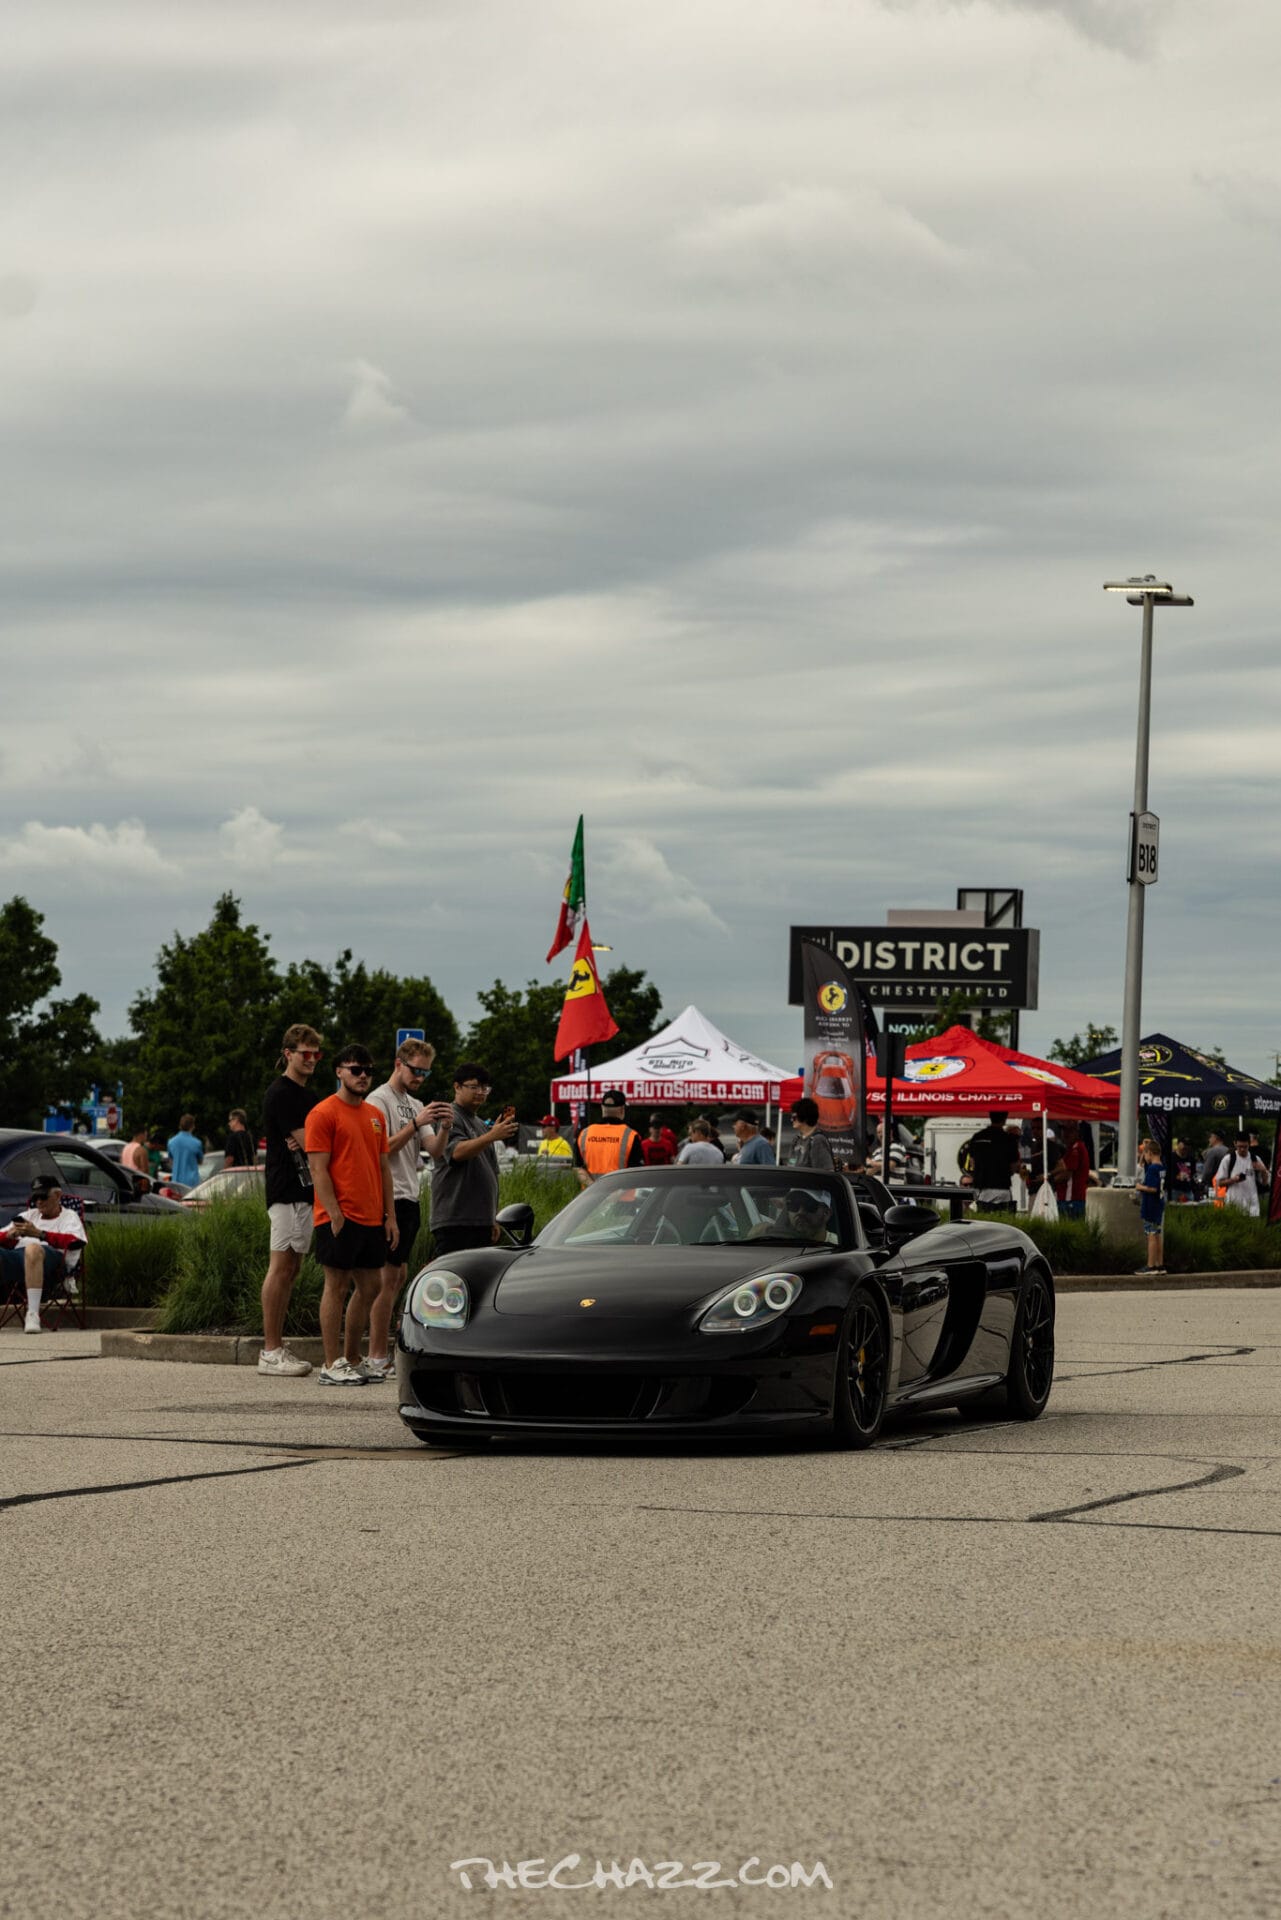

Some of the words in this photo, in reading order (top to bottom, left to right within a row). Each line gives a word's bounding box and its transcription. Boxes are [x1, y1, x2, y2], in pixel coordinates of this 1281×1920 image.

[1139, 845, 1157, 873] B18
[837, 941, 1010, 971] DISTRICT
[887, 1023, 925, 1036] NOW
[896, 1091, 955, 1102] ILLINOIS
[958, 1092, 1024, 1102] CHAPTER
[1140, 1092, 1201, 1112] Region
[587, 1135, 620, 1144] VOLUNTEER
